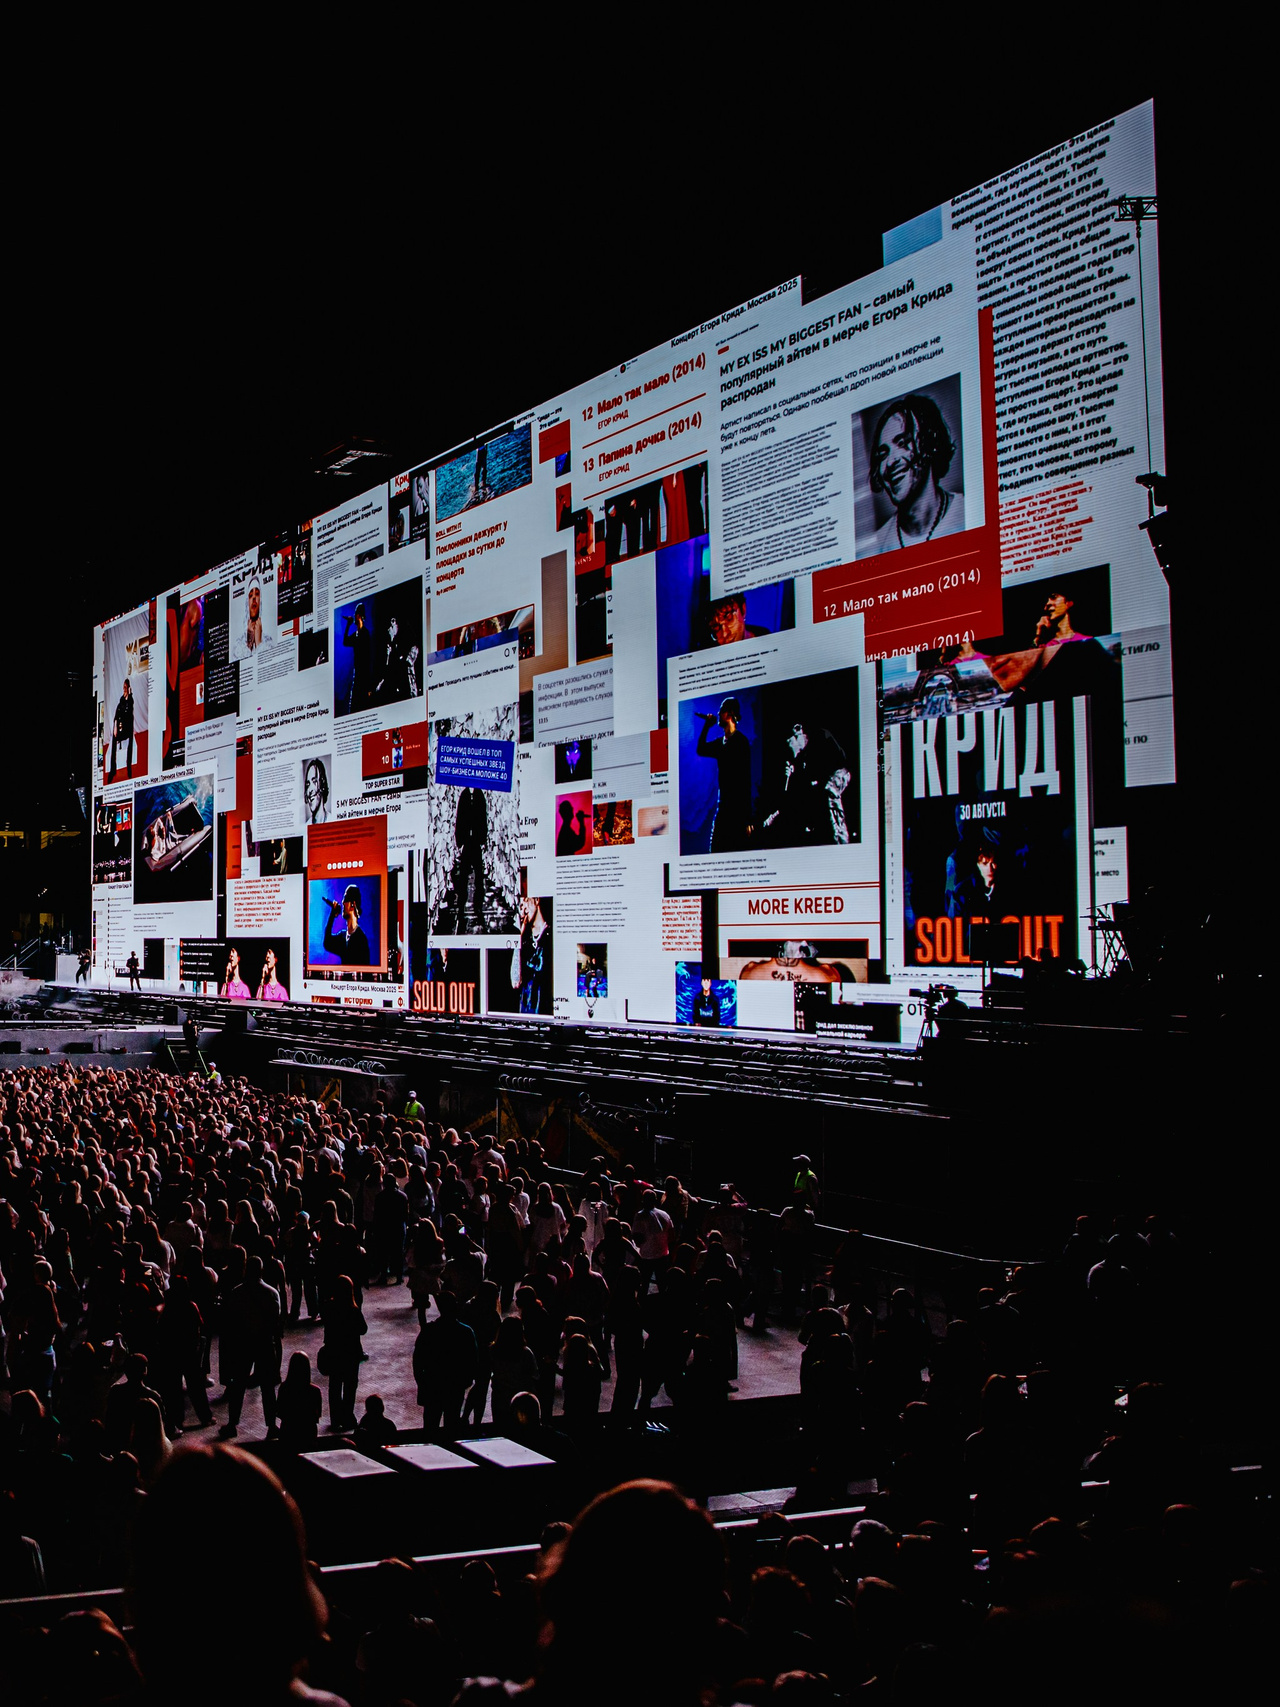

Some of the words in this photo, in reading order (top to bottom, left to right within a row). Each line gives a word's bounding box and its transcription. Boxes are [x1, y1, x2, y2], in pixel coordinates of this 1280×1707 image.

[670, 328, 699, 348] Концерт
[699, 318, 720, 333] Егора
[720, 306, 746, 323] Крида.
[746, 290, 776, 310] Москва
[777, 278, 797, 295] 2025
[719, 360, 735, 376] MY
[736, 353, 750, 369] EX
[752, 345, 768, 362] ISS
[769, 336, 786, 354] MY
[788, 314, 835, 345] BIGGEST
[837, 302, 861, 323] FAN
[872, 278, 914, 307] самый
[720, 355, 784, 392] популярный
[786, 341, 820, 363] айтем
[832, 320, 869, 343] мерче
[872, 303, 907, 326] Егора
[910, 283, 952, 309] Крида
[581, 406, 593, 421] 12
[597, 395, 622, 414] Мало
[624, 385, 642, 401] так
[643, 372, 670, 393] мало
[671, 352, 705, 382] (2014)
[720, 416, 742, 436] Артист
[777, 385, 820, 407] социальных
[844, 370, 857, 379] что
[858, 355, 893, 374] позиции
[901, 340, 928, 356] мерче
[929, 335, 941, 345] не
[720, 378, 775, 411] распродан
[782, 401, 810, 416] Однако
[810, 385, 848, 405] пообещал
[849, 376, 870, 391] дроп
[871, 365, 896, 381] новой
[897, 347, 943, 370] коллекции
[597, 416, 611, 429] ЕГОР
[612, 409, 628, 422] КРИД
[582, 457, 594, 472] 13
[598, 444, 633, 466] Папина
[634, 430, 665, 454] дочка
[667, 411, 701, 440] (2014)
[598, 469, 612, 481] ЕГОР
[613, 462, 630, 475] КРИД
[495, 536, 505, 548] до
[824, 603, 836, 616] 12
[843, 597, 874, 612] Мало
[877, 591, 898, 604] так
[902, 582, 934, 598] мало
[938, 568, 980, 591] (2014)
[866, 651, 887, 662] ина
[381, 754, 389, 764] 10
[440, 744, 452, 752] ЕГОР
[452, 746, 466, 756] КРИД
[490, 749, 502, 757] ТОП
[912, 700, 1061, 798] КРИД
[364, 781, 373, 789] TOP
[388, 776, 400, 785] STAR
[959, 803, 971, 821] 30
[972, 801, 1006, 820] АВГУСТА
[748, 898, 790, 915] MORE
[793, 896, 844, 914] KREED
[914, 915, 990, 964] SOL
[413, 980, 446, 1012] SOLD
[449, 982, 476, 1014] OUT
